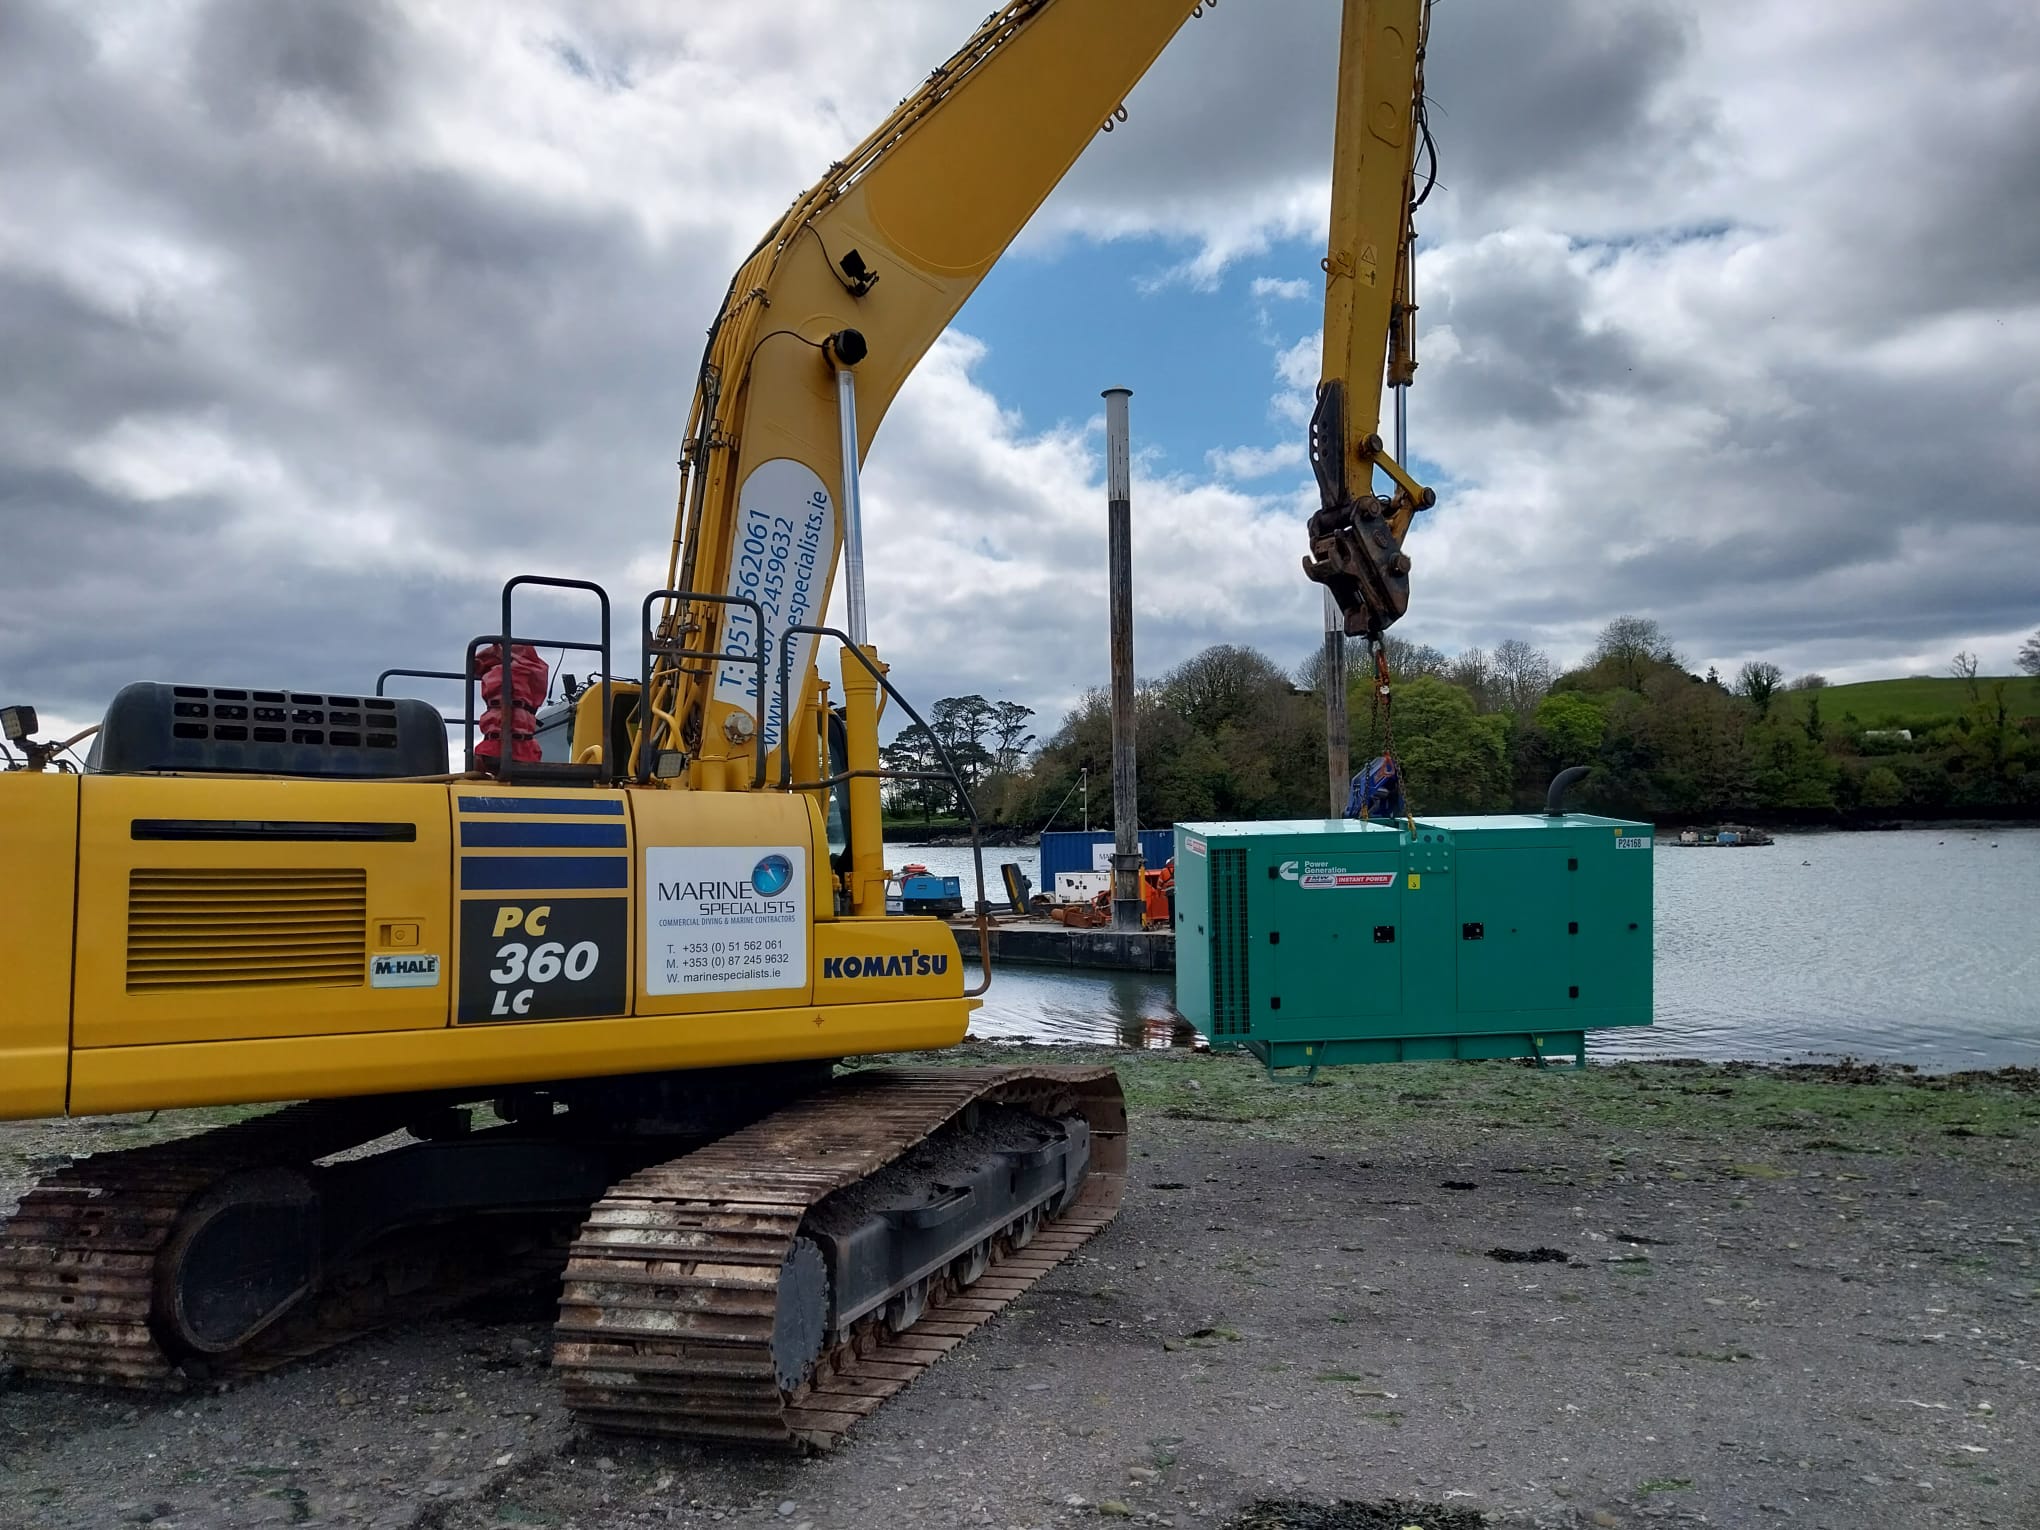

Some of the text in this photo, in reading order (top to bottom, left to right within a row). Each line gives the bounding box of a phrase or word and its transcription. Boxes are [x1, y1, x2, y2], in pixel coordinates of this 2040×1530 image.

[719, 509, 771, 687] T: 051-562061
[763, 491, 828, 746] wwwmariespecialists.ie
[1304, 860, 1329, 868] Power
[1304, 866, 1347, 874] Generation
[658, 881, 753, 901] MARINE
[699, 901, 795, 916] SPECIALISTS
[492, 905, 551, 937] PC
[659, 915, 796, 927] COMMERCIAL DIVING & MARINE CONTRACTORS
[666, 940, 782, 954] T. +353 (0) 51 562 061
[490, 941, 599, 985] 360
[666, 953, 789, 969] M. +353 (0) 87 245 9632
[823, 949, 948, 978] KOMATSU
[666, 968, 781, 983] W. marinespecialists.ie
[491, 989, 534, 1016] LC
